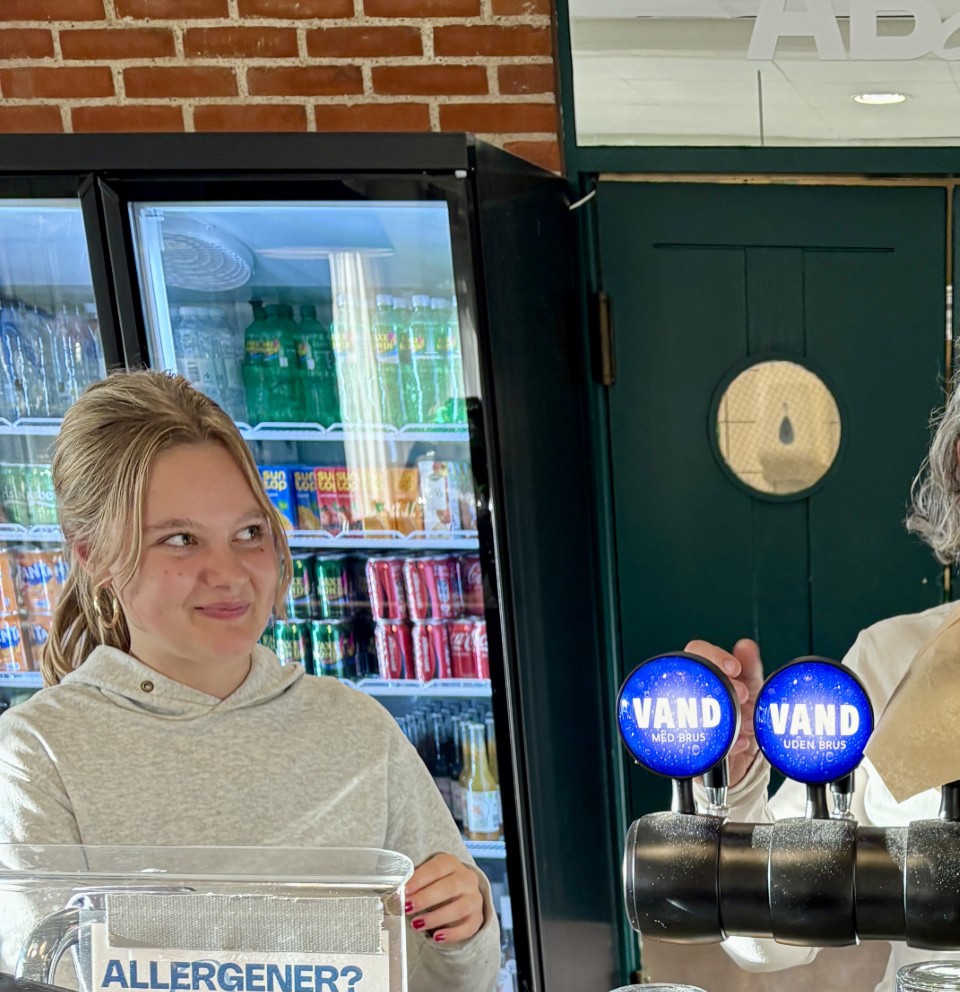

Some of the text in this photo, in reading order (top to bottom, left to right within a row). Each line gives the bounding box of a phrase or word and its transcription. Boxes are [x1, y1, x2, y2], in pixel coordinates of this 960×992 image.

[632, 697, 722, 729] VAND
[769, 703, 860, 736] VAND
[651, 732, 706, 743] MED BRUS
[783, 739, 847, 750] UDEN BRUS
